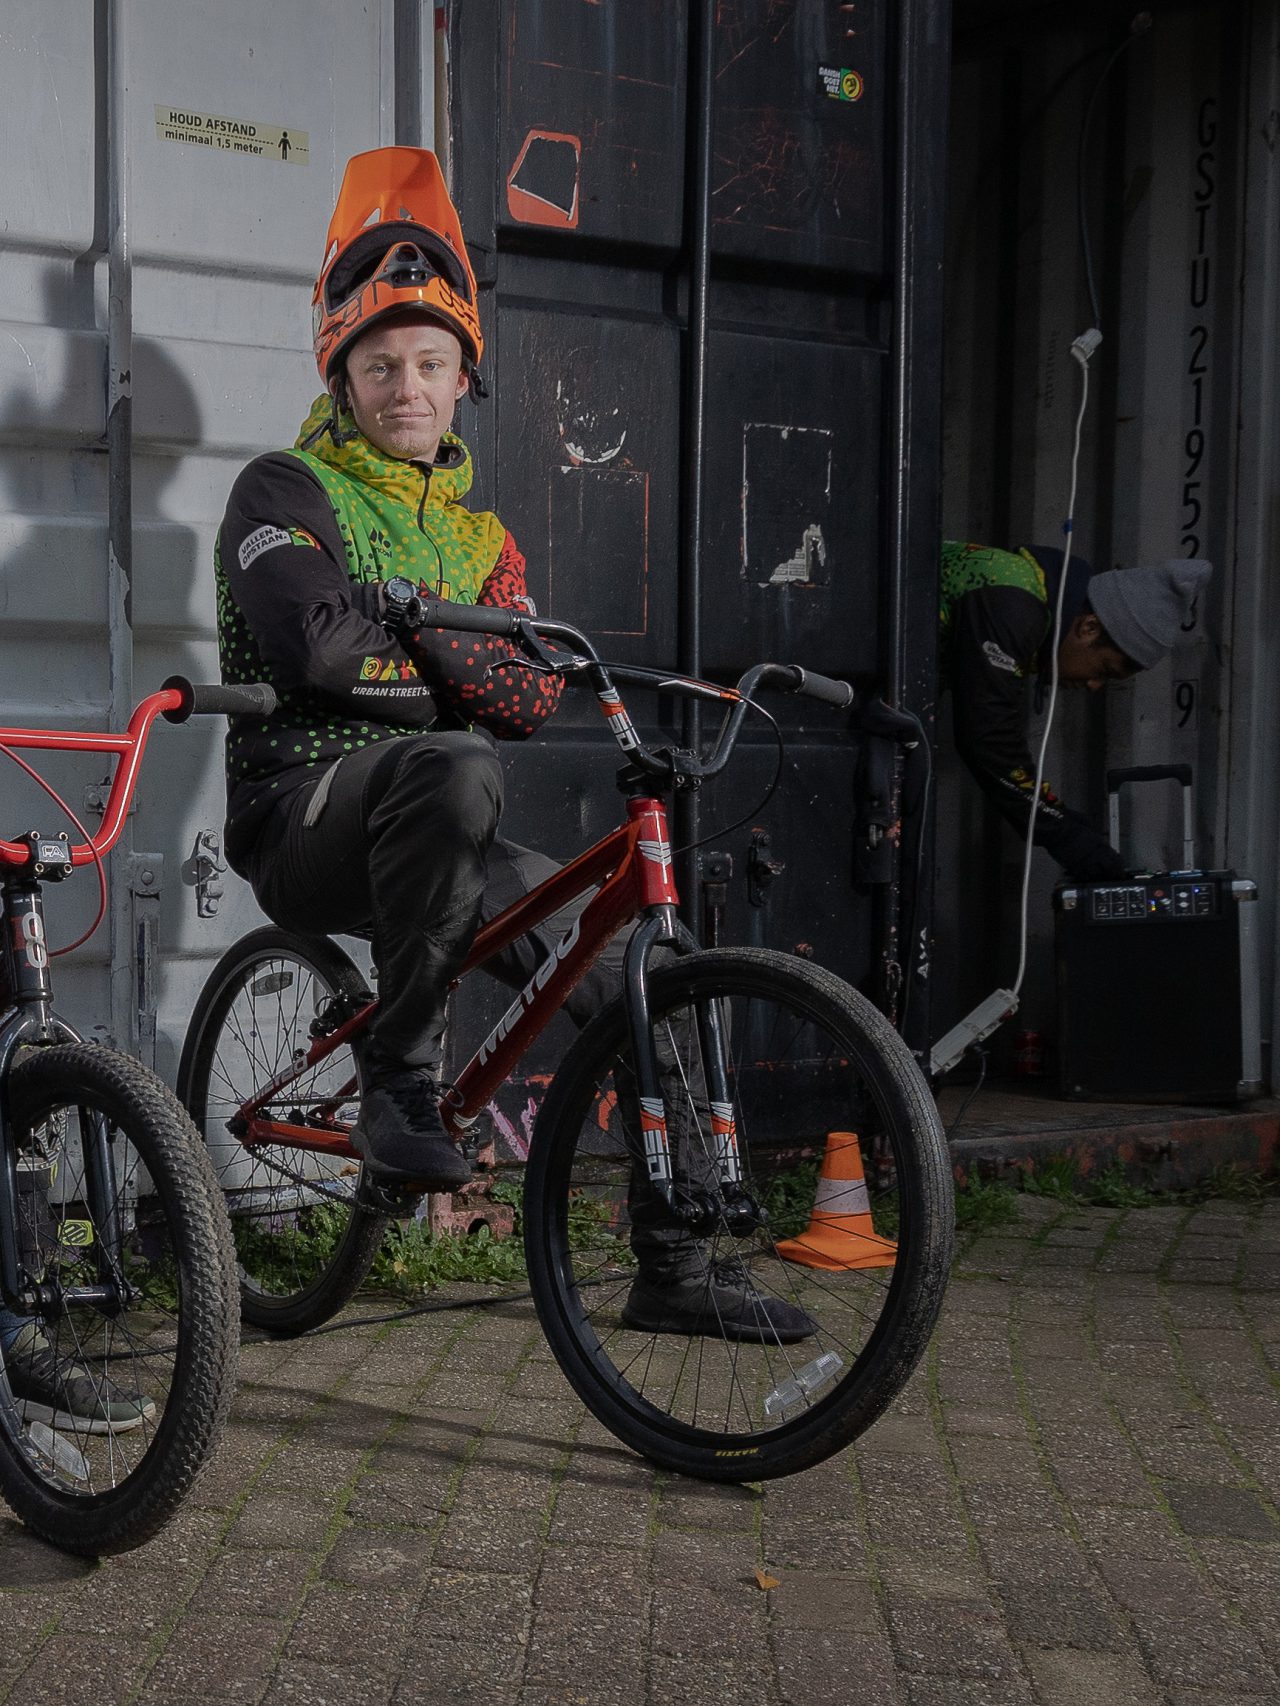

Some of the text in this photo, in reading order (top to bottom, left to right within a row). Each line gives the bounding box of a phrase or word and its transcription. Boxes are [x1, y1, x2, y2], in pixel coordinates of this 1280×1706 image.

[170, 112, 256, 137] HOUD AFSTAND
[165, 130, 263, 155] minimaal 1,5 meter
[1190, 98, 1216, 308] GSTU
[241, 528, 274, 554] VALLEN
[242, 533, 287, 564] OPSTAAN.
[352, 686, 388, 697] URBAN
[388, 686, 422, 697] STREET
[477, 912, 583, 1066] MEYBO
